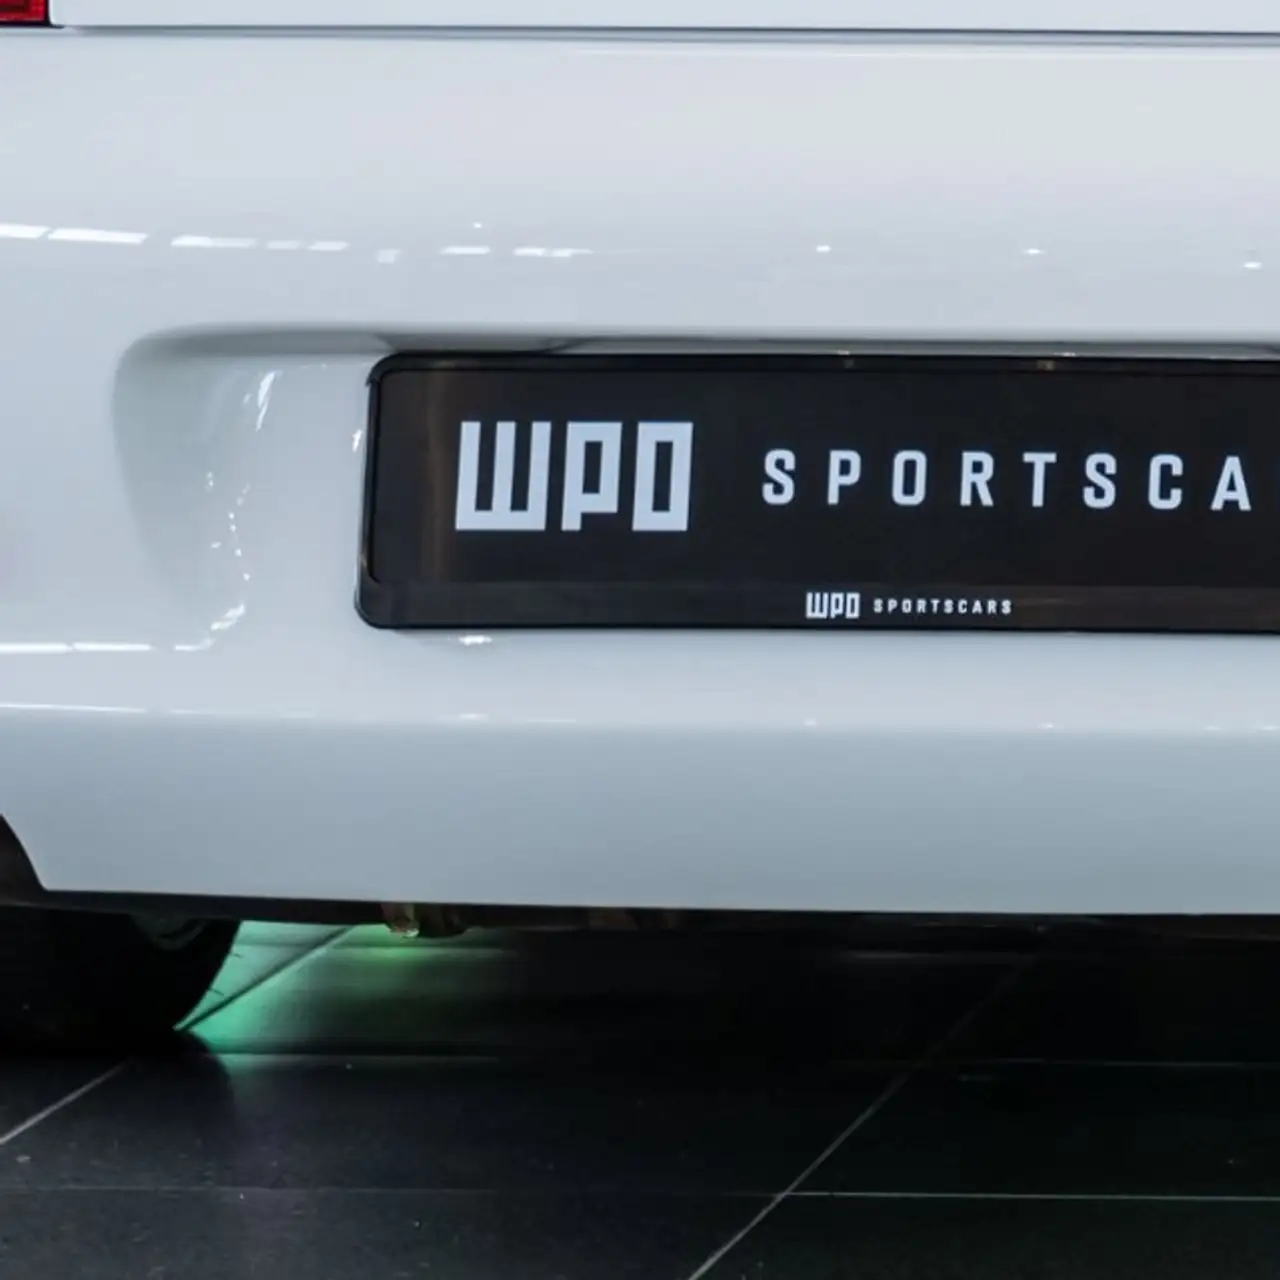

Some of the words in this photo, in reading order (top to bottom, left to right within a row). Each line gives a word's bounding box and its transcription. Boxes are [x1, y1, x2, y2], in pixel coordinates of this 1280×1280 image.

[455, 420, 694, 532] WPO
[805, 591, 861, 619] WPO
[872, 598, 1012, 615] SPORTSCARS
